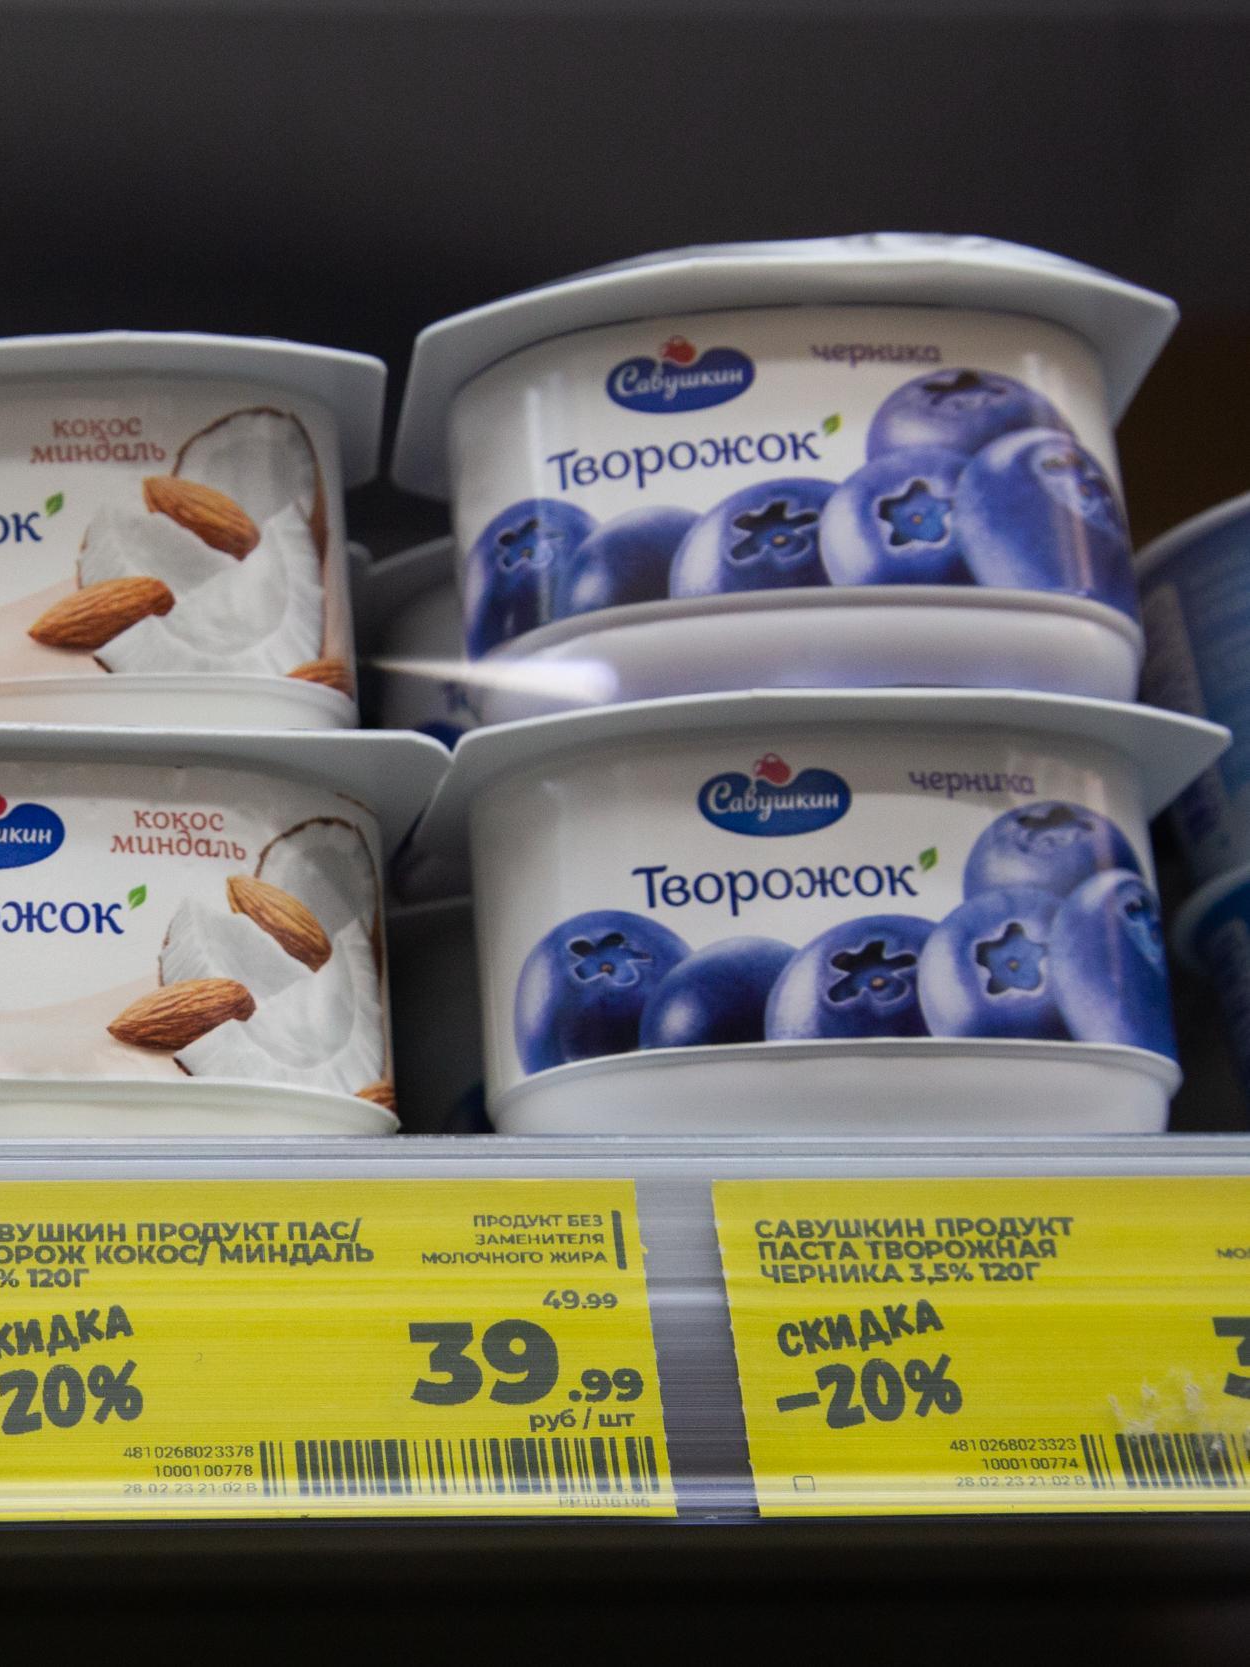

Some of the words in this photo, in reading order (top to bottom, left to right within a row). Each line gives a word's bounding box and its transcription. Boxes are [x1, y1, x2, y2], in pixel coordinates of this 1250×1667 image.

[810, 342, 943, 368] черника
[614, 364, 743, 400] Савушкин
[53, 416, 142, 438] кокос
[30, 439, 167, 464] миндаль
[548, 431, 823, 491] Творожок
[909, 771, 1037, 799] черника
[708, 782, 839, 822] Савушкин
[134, 810, 225, 832] кокос
[110, 831, 247, 861] миндаль
[632, 864, 919, 917] Творожок
[136, 1221, 280, 1247] ПРОДУКТ
[287, 1217, 362, 1243] ПАС/
[473, 1214, 562, 1229] ПРОДУКТ
[567, 1214, 604, 1227] БЕЗ
[754, 1218, 925, 1239] САВУШКИН
[934, 1216, 1074, 1240] ПРОДУКТ
[475, 1233, 605, 1246] ЗАМЕНИТЕЛЯ
[757, 1240, 860, 1261] ПАСТА
[864, 1238, 1059, 1260] ТВОРОЖНАЯ
[219, 1242, 375, 1267] МИНДАЛЬ
[421, 1251, 544, 1265] МОЛОЧНОГО
[549, 1250, 608, 1264] ЖИРА
[26, 1267, 90, 1288] 120Г
[760, 1263, 904, 1284] ЧЕРНИКА
[909, 1263, 974, 1286] 3,5%
[979, 1262, 1041, 1281] 120Г
[542, 1289, 619, 1310] 49.99
[776, 1299, 945, 1357] СКИДКА
[775, 1353, 963, 1430] -20%
[528, 1408, 577, 1433] руб
[598, 1412, 636, 1427] шт
[123, 1446, 254, 1459] 4810268023378
[949, 1438, 1076, 1452] 4810268023323
[154, 1465, 254, 1477] 1000100778
[982, 1457, 1078, 1470] 1000100774
